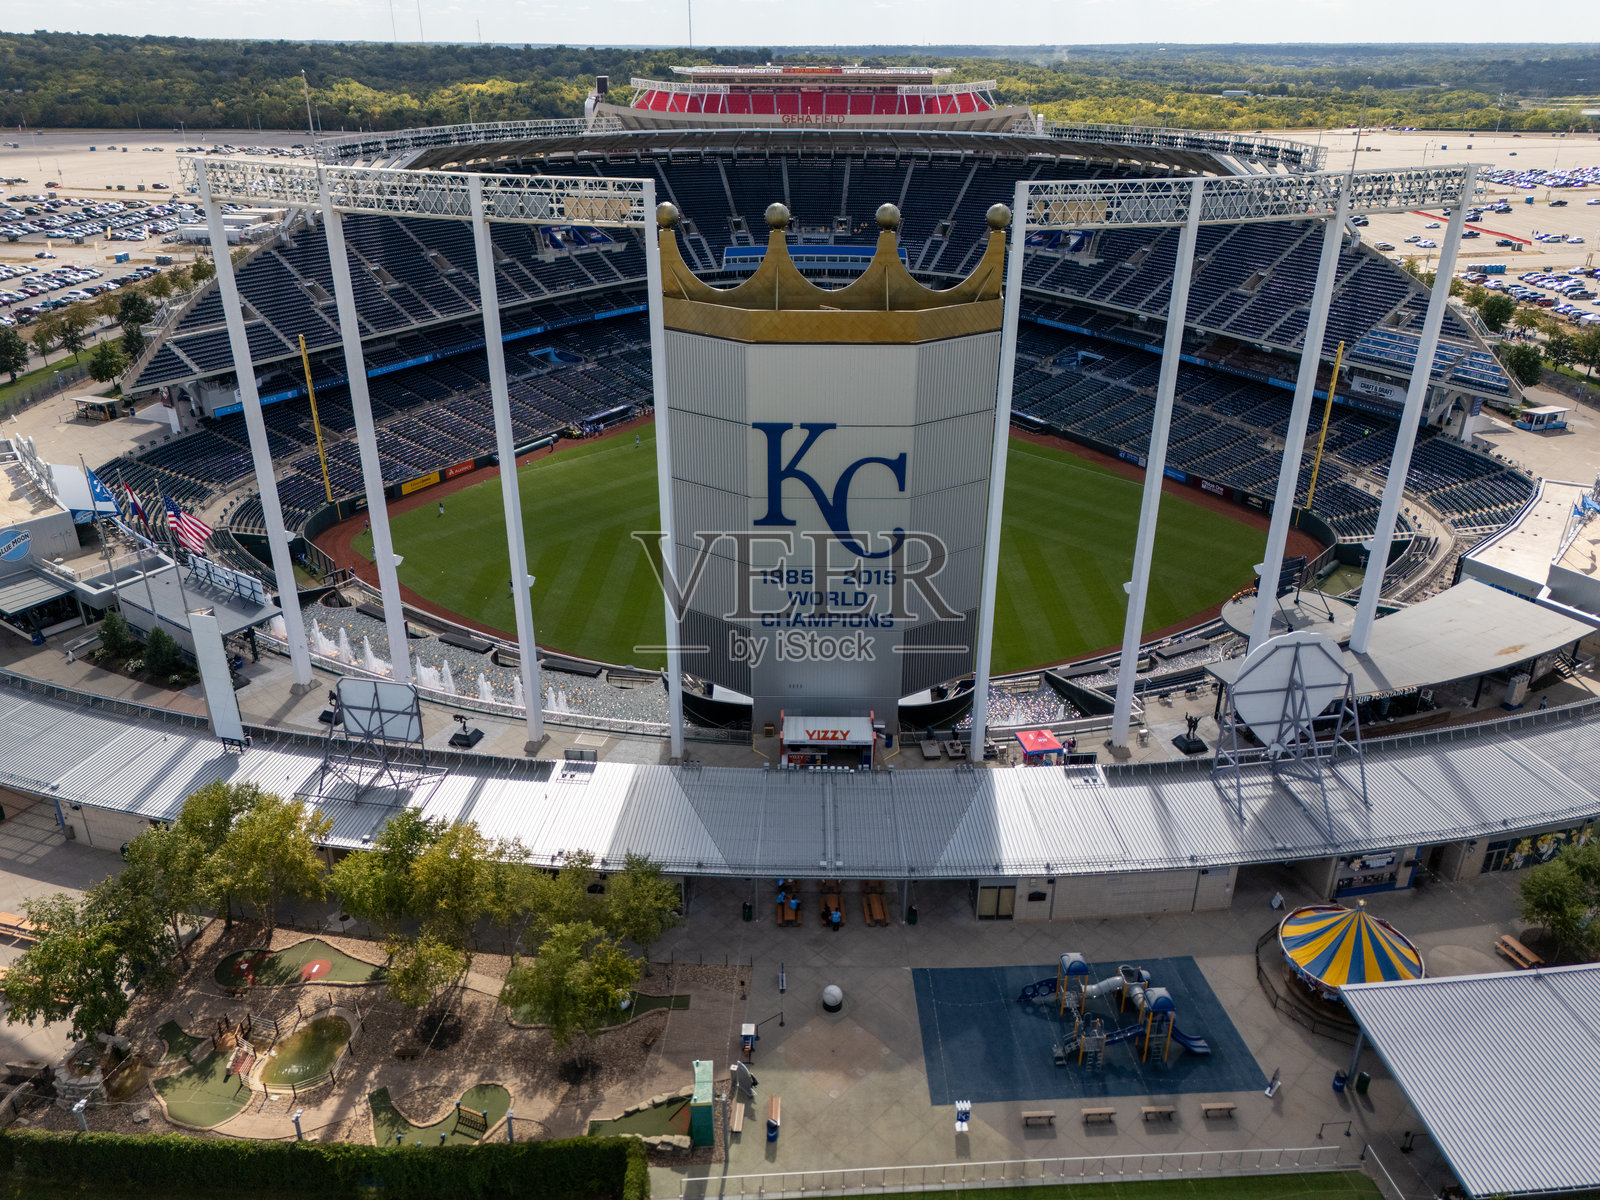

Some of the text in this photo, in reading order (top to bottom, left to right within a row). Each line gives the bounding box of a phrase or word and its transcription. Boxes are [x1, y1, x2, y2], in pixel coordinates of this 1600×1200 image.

[782, 114, 845, 124] GEHA FIELD
[1360, 382, 1374, 391] CRAFT
[1378, 386, 1393, 396] DRAFT
[752, 422, 907, 559] KC
[12, 533, 30, 547] MOON
[760, 569, 897, 585] 1985 2015
[788, 591, 868, 607] WORLD
[761, 612, 894, 628] CHAMPIONS
[1371, 688, 1404, 702] FOUNTAIN
[1404, 686, 1418, 695] BAR
[805, 729, 851, 740] VIZZY
